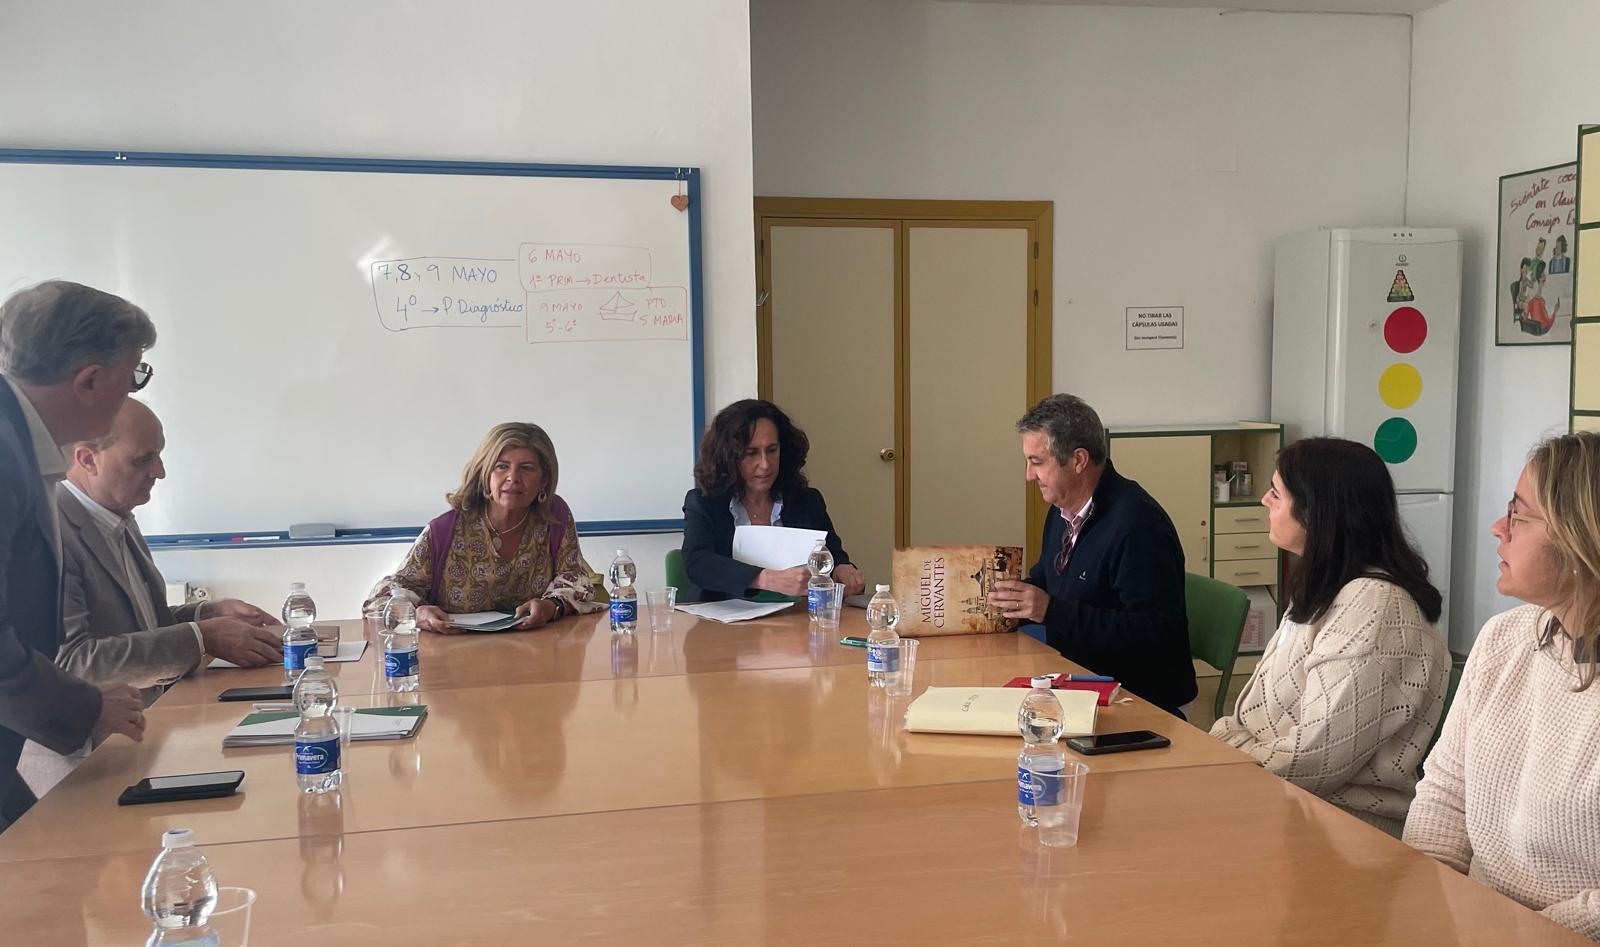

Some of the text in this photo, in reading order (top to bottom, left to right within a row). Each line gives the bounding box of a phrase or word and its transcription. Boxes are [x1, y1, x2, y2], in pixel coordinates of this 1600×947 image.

[1535, 200, 1546, 209] en
[1525, 212, 1561, 234] Consejos
[528, 248, 582, 264] 6 MAYO
[427, 264, 440, 282] 9
[452, 265, 498, 283] MAYO
[548, 274, 574, 287] PRIM
[592, 269, 647, 284] Dentista
[458, 297, 524, 323] Diagnóstico
[540, 302, 584, 313] 9 MAYO
[920, 559, 932, 623] MIGUEL DE
[933, 556, 945, 629] CERVANTES
